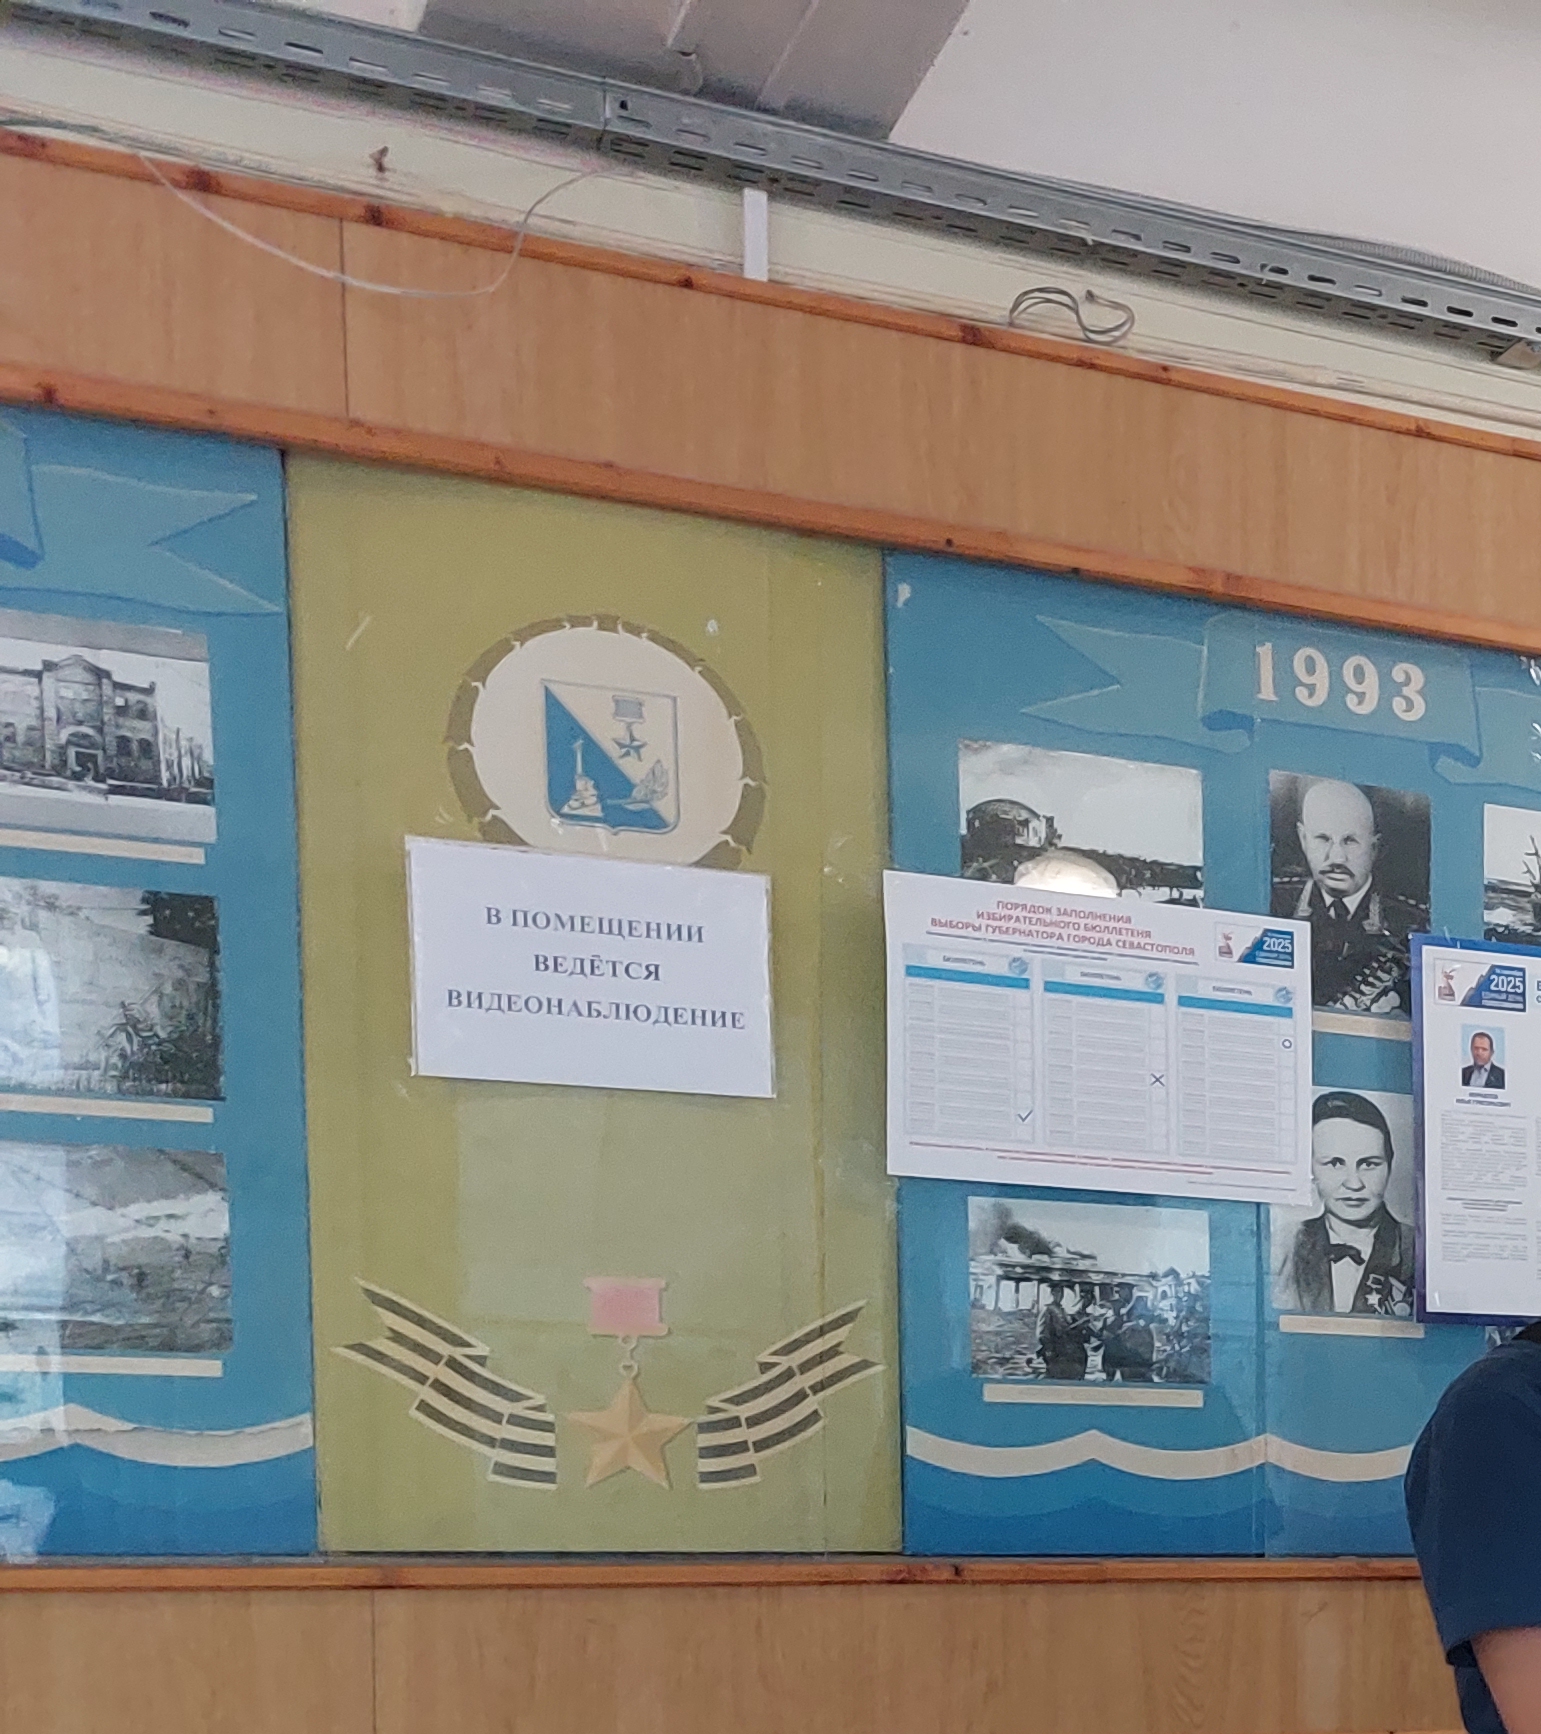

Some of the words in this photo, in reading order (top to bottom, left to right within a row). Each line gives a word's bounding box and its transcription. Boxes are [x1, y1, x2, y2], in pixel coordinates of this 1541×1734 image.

[1255, 642, 1427, 722] 1993
[485, 906, 503, 926] В
[511, 908, 705, 944] ПОМЕЩЕНИИ
[976, 910, 1081, 931] ИЗБИРАТЕЛЬНОГО
[1083, 922, 1152, 940] БЮЛЛЕТЕНЯ
[996, 900, 1053, 916] ПОРЯДОК
[1056, 907, 1132, 925] ЗАПОЛНЕНИЯ
[930, 917, 982, 933] ВЫБОРЫ
[984, 924, 1065, 943] ГУБЕРНАТОРА
[1066, 933, 1113, 948] ГОРОДА
[1115, 939, 1195, 957] СЕВАСТОПОЛЯ
[1262, 936, 1292, 953] 2025
[533, 953, 662, 982] ВЕДЁТСЯ
[1489, 974, 1524, 994] 2025
[446, 988, 746, 1030] ВИДЕОНАБЛЮДЕНИЕ
